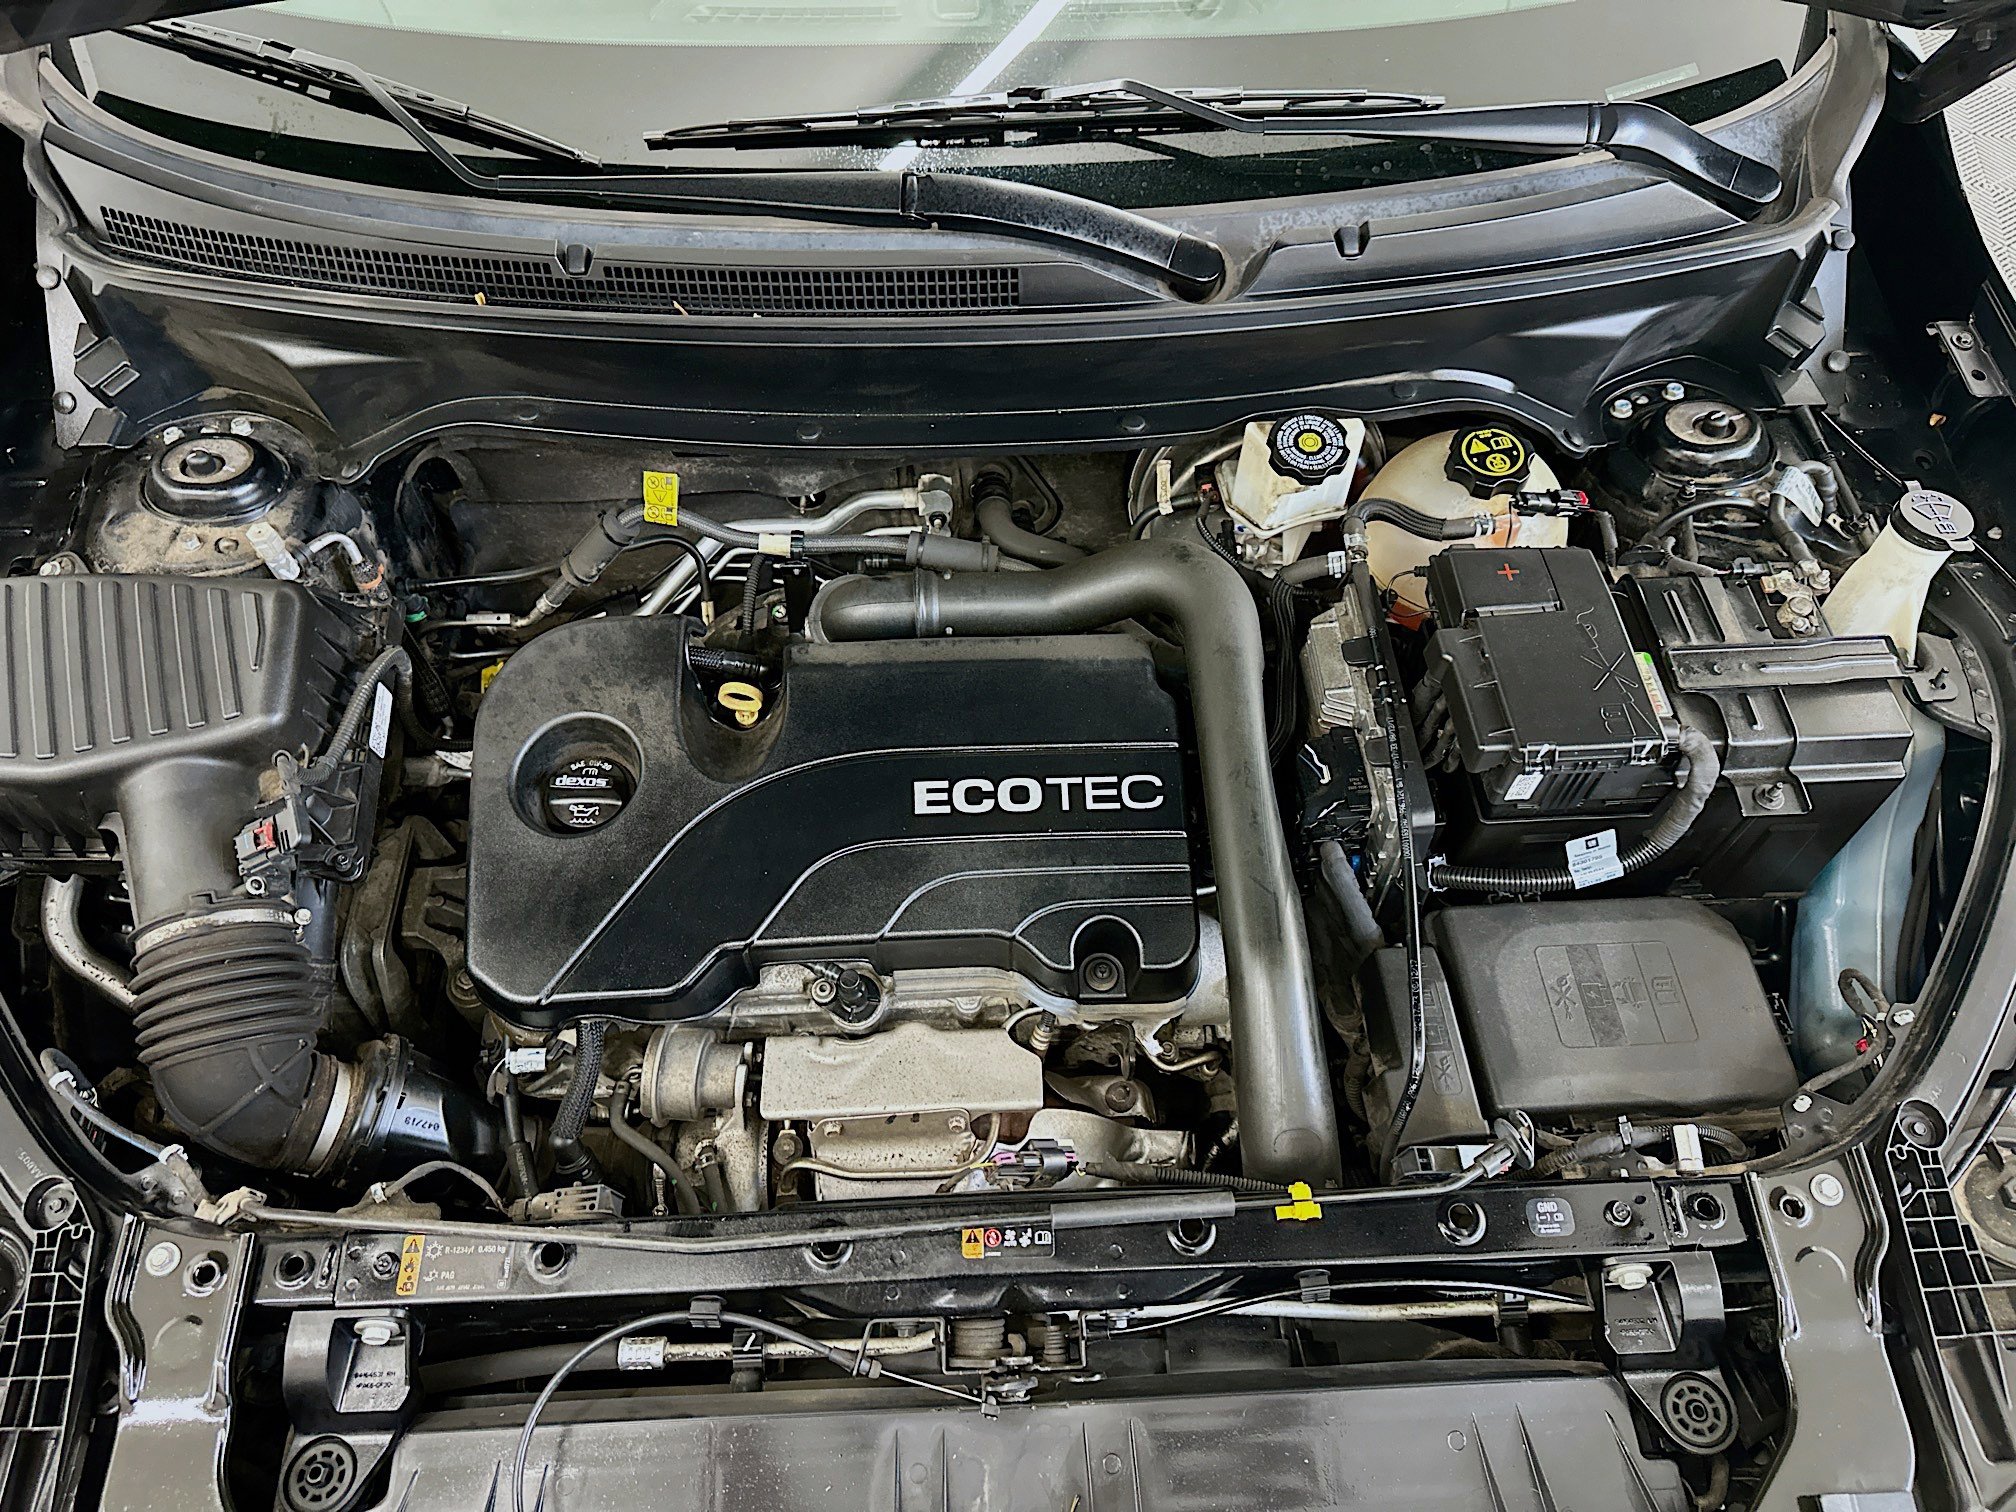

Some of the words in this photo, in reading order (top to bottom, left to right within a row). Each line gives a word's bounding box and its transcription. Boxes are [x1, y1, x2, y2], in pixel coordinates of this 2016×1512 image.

[555, 774, 610, 787] dexos
[913, 774, 1164, 815] ECOTEC
[1536, 1201, 1558, 1213] GND
[440, 1270, 455, 1280] PAG
